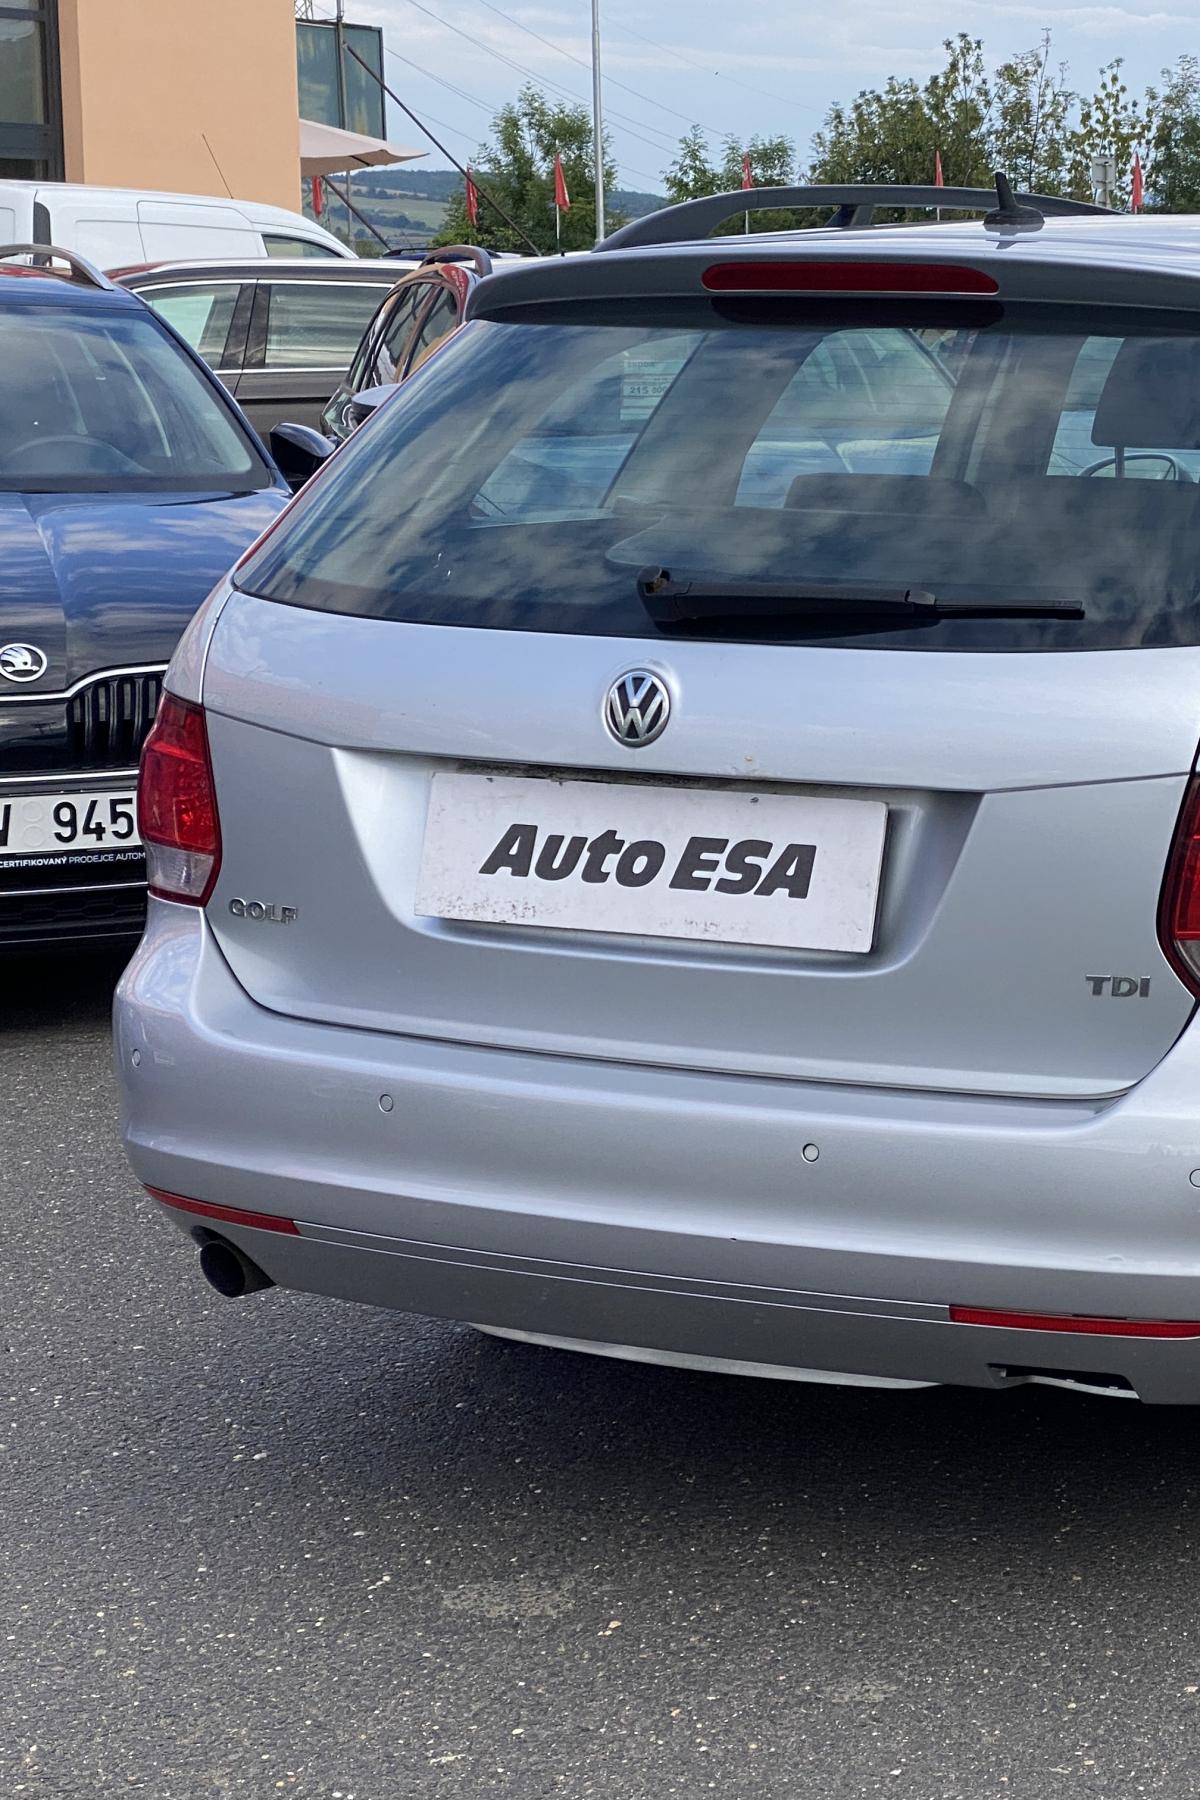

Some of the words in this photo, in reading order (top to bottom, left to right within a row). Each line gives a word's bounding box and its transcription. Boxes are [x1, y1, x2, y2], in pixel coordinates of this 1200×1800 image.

[68, 853, 114, 865] PRODEJCE
[479, 823, 666, 888] Auto
[669, 836, 817, 899] ESA
[229, 897, 297, 925] GOLF
[1085, 974, 1151, 998] TDI
